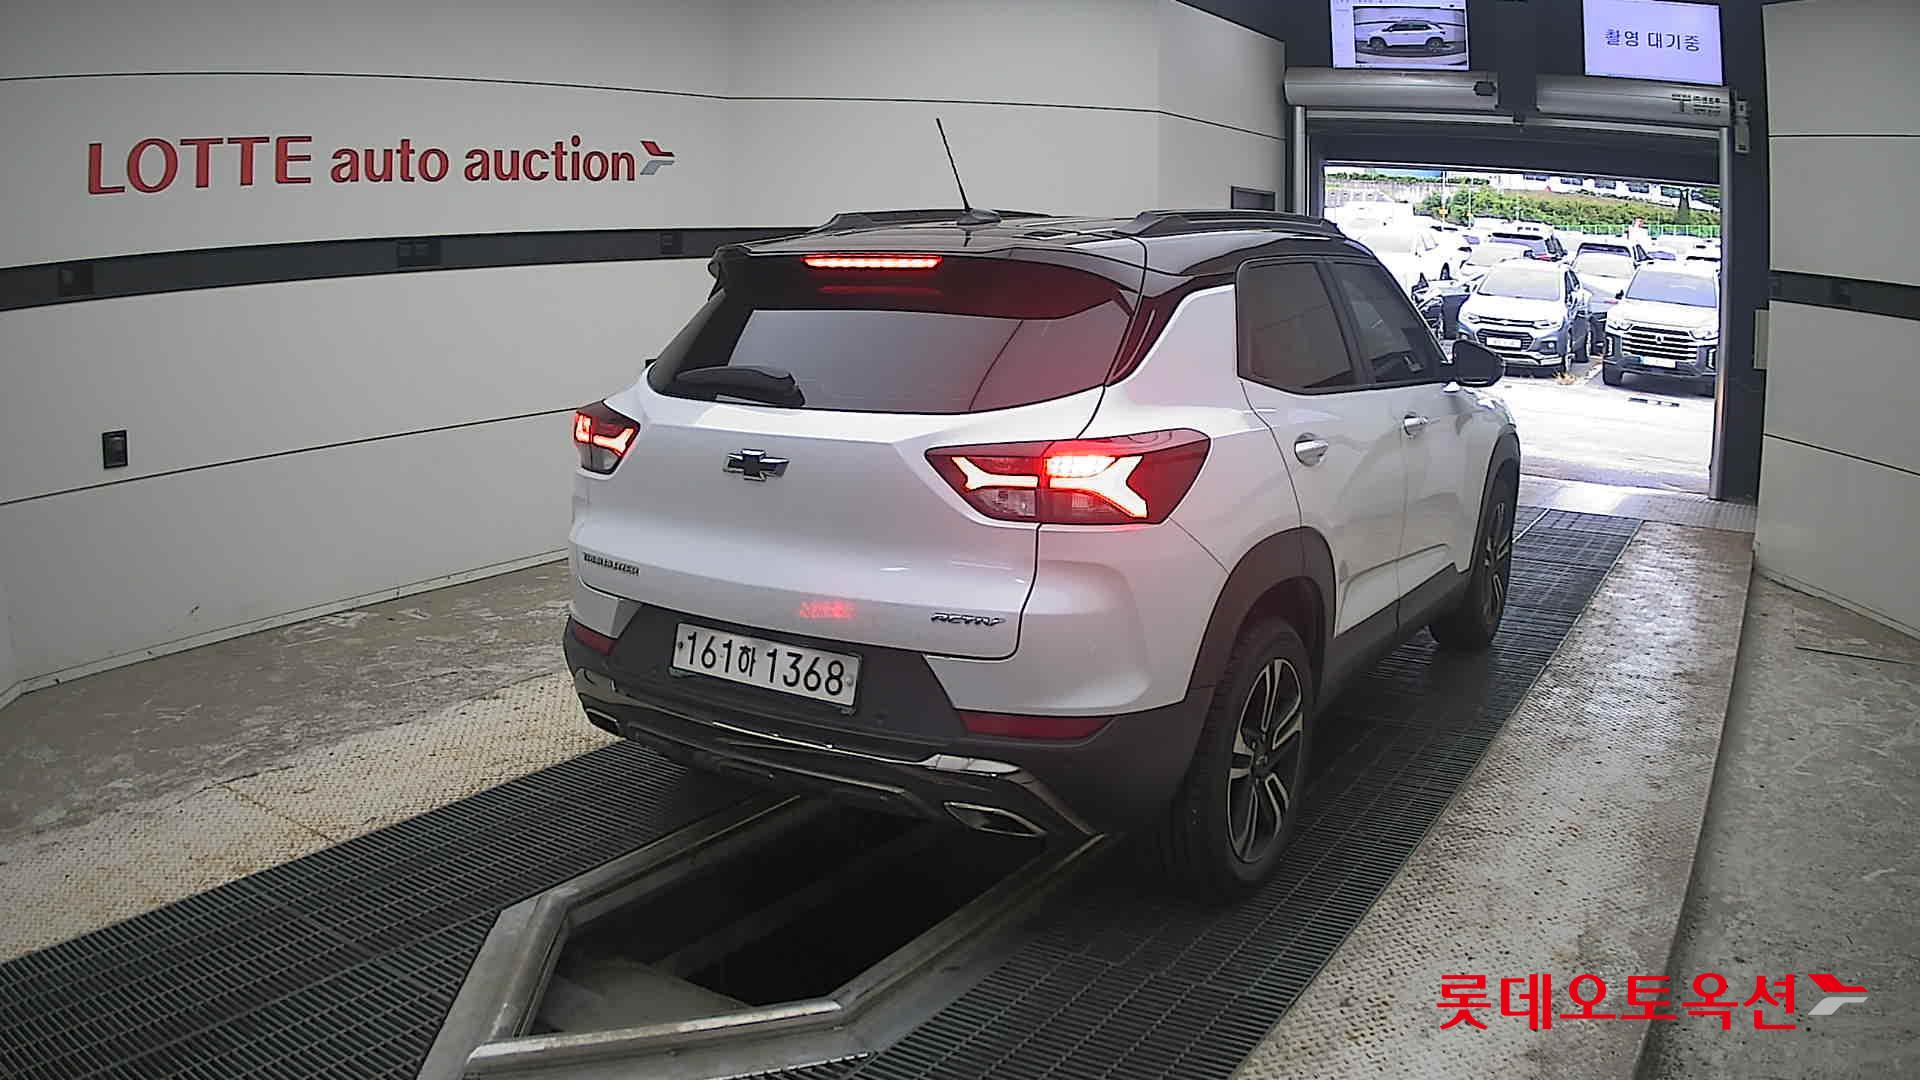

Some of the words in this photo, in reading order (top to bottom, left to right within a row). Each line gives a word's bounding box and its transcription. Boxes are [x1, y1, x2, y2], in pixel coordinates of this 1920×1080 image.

[1647, 31, 1701, 53] 대기중
[87, 135, 312, 196] LOTTE
[329, 138, 450, 184] auto
[462, 134, 637, 183] auction
